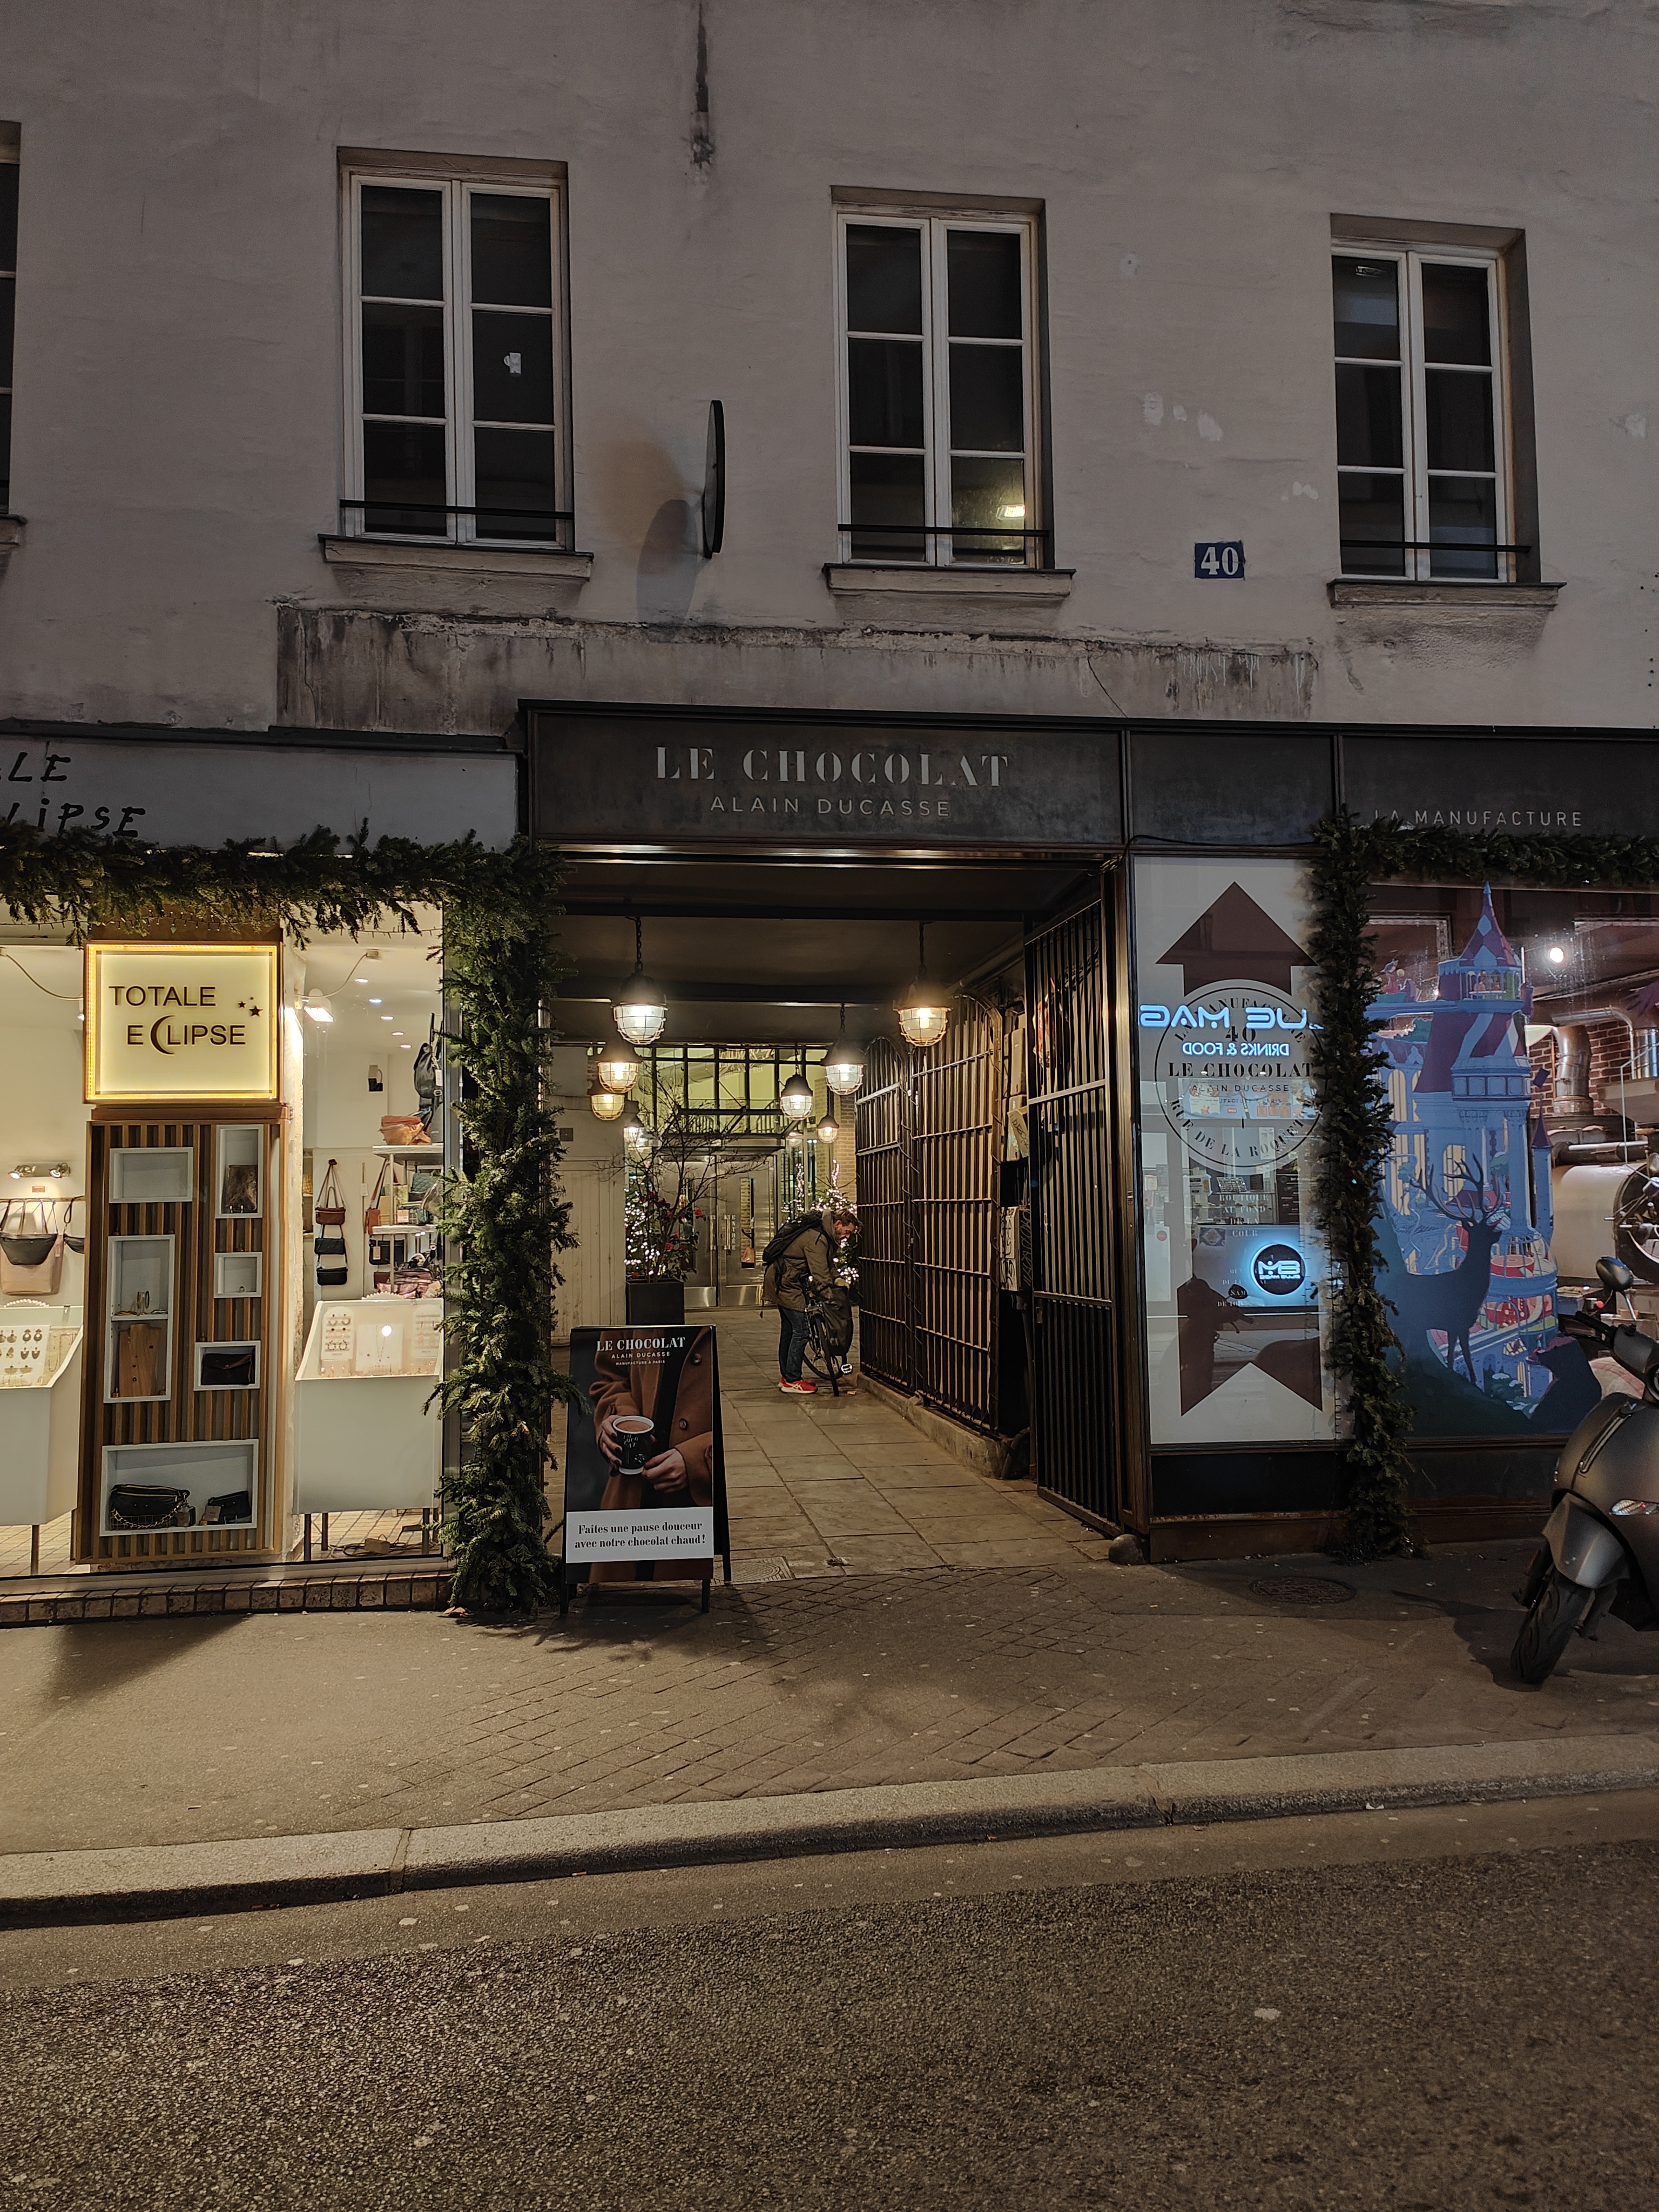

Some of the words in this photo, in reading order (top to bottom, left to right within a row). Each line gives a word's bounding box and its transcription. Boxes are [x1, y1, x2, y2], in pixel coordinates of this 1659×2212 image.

[1201, 547, 1239, 575] 40
[0, 752, 71, 782] LE
[656, 747, 714, 779] LE
[743, 749, 1008, 786] CHOCOLAT
[711, 796, 798, 813] ALAIN
[818, 799, 950, 817] DUCASSE
[1415, 810, 1582, 826] MANUFACTURE
[108, 986, 216, 1006] TOTALE
[1225, 1026, 1256, 1043] 40
[1168, 1062, 1193, 1076] LE
[1204, 1062, 1313, 1077] CHOCOLAT
[1194, 1131, 1216, 1150] DE
[1220, 1143, 1242, 1158] LA
[596, 1340, 613, 1352] LE
[617, 1337, 686, 1351] CHOCOLAT
[578, 1525, 608, 1534] Faites
[611, 1525, 629, 1533] une
[631, 1524, 660, 1535] pause
[662, 1522, 703, 1532] douceur
[575, 1539, 597, 1548] avec
[599, 1538, 625, 1548] notre
[628, 1536, 669, 1546] chocolat
